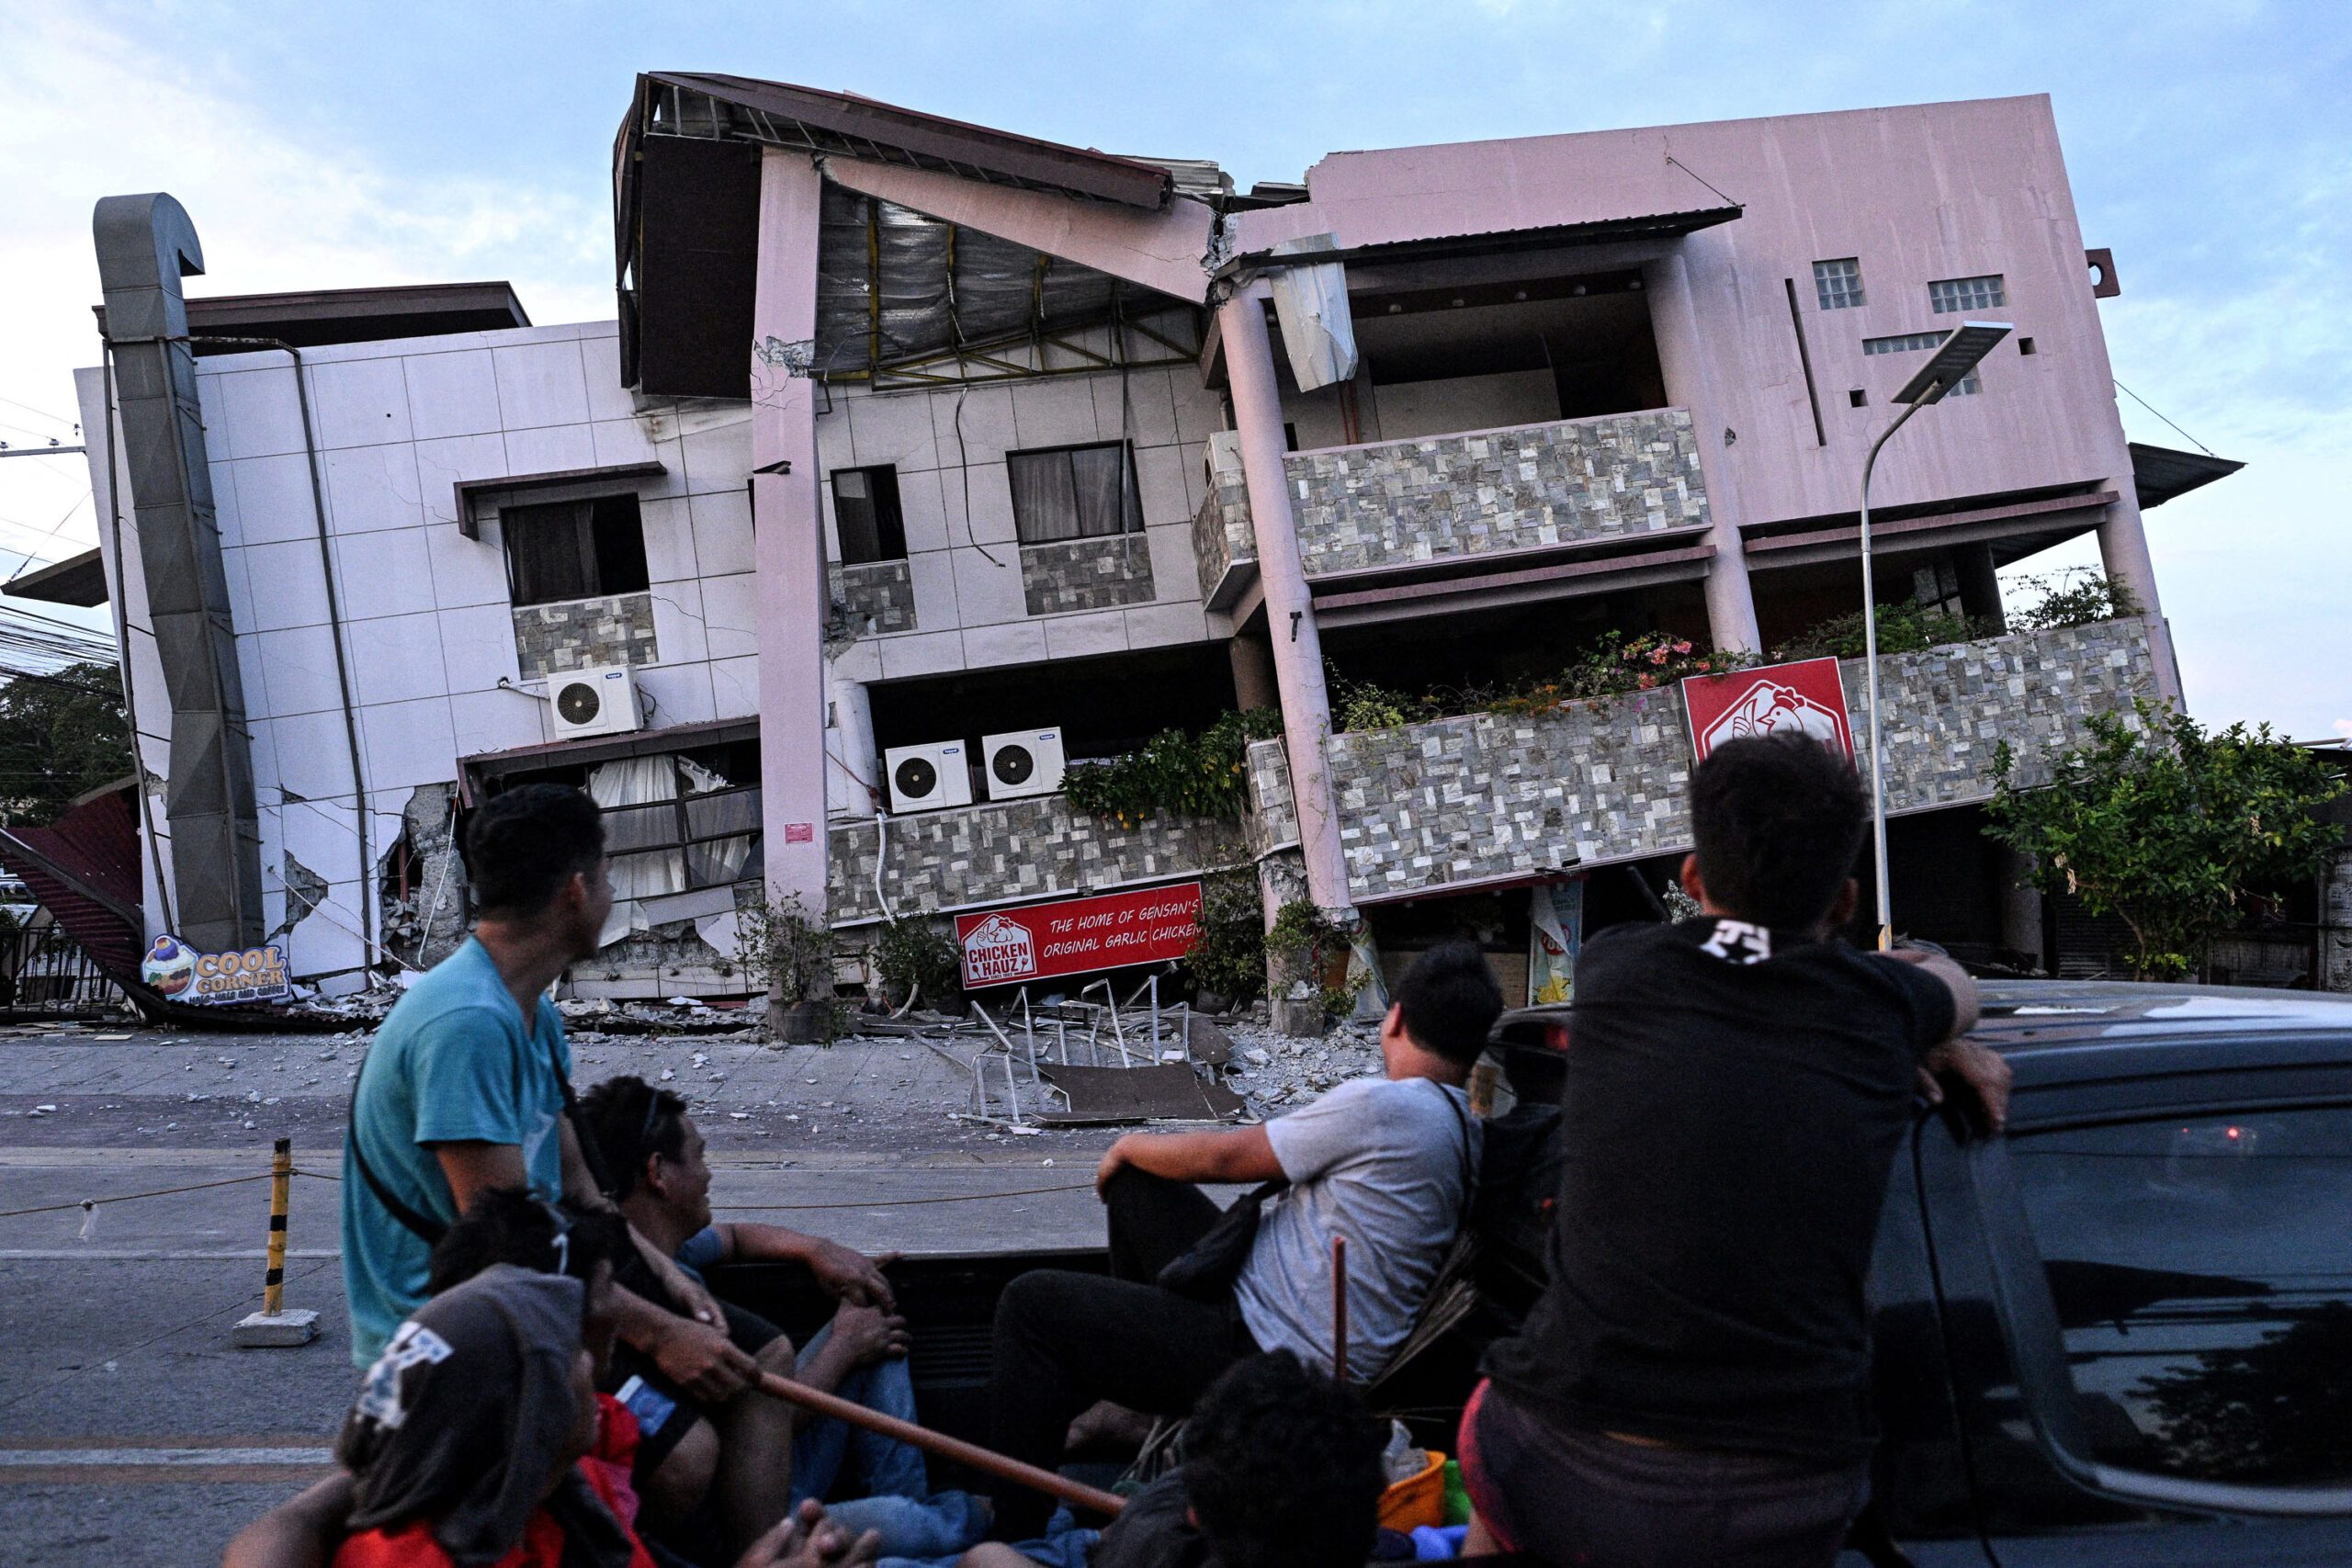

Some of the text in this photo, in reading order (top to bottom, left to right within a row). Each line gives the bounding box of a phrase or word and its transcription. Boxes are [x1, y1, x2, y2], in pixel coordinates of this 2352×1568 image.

[1050, 899, 1199, 933] THE HOME OF GENSAN'S
[968, 942, 1028, 964] CHICKEN
[1043, 923, 1202, 958] ORIGINAL GARLIC CHICKEN
[196, 947, 284, 977] COOL
[982, 958, 1018, 976] HAUZ
[197, 969, 284, 994] CORNER
